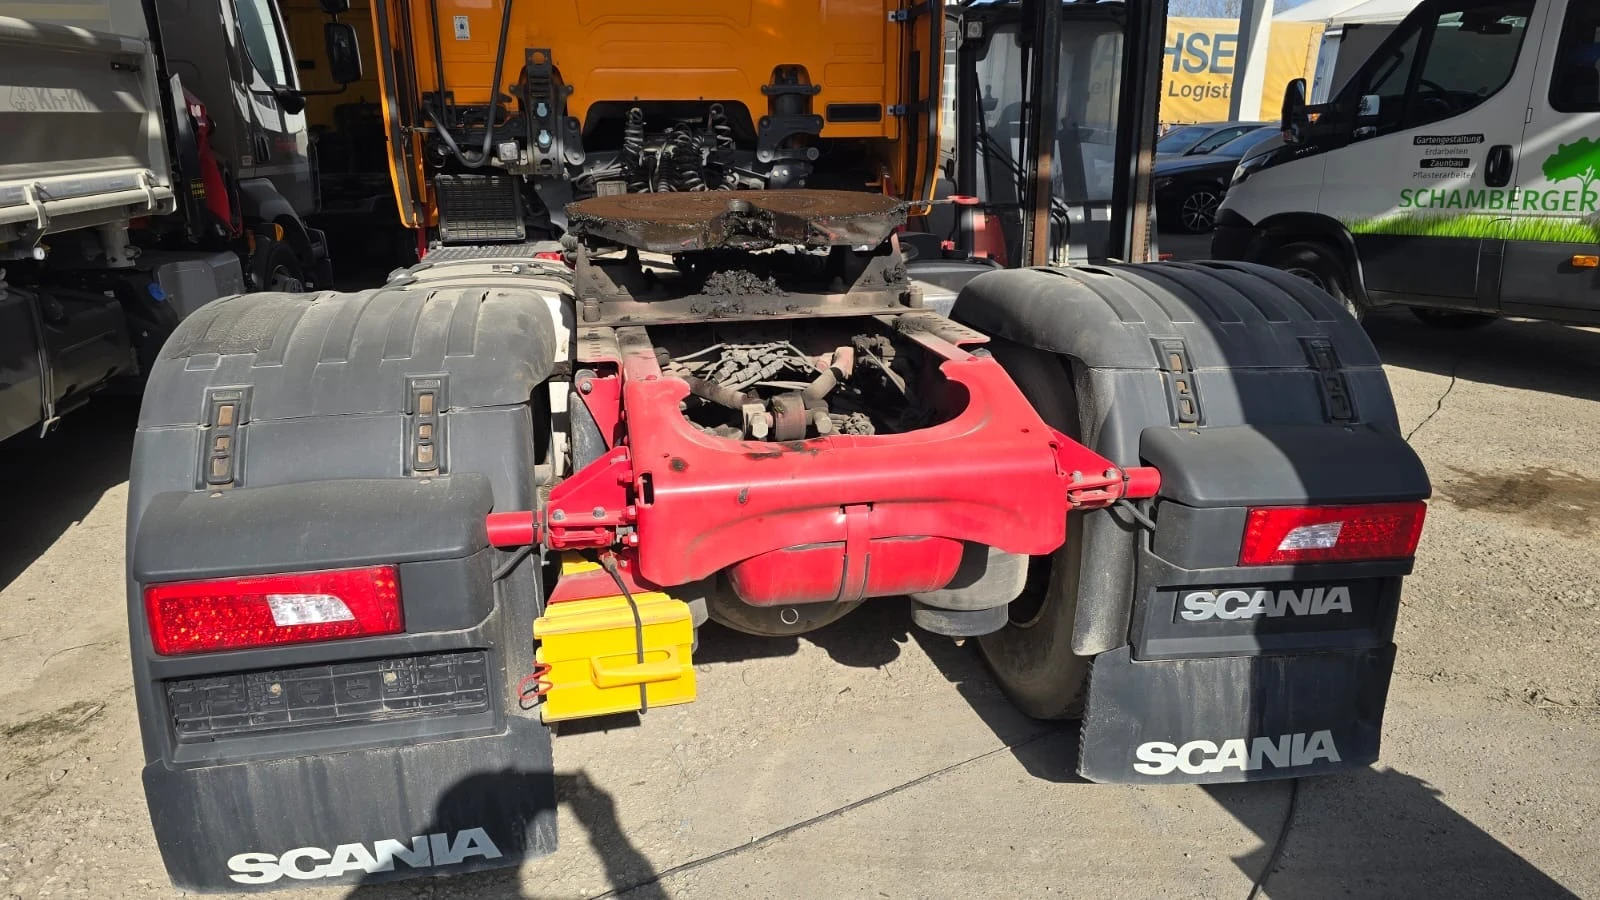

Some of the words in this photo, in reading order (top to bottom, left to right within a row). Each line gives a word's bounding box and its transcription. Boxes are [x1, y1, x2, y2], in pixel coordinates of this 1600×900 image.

[1164, 32, 1239, 74] HSE
[1416, 135, 1482, 145] Gartengestaltung
[1425, 147, 1468, 155] Erdarbeiten
[1412, 171, 1476, 179] Pflasterarbeiten
[1430, 159, 1464, 167] Zaunbau
[1398, 188, 1599, 212] SCHAMBERGER
[1181, 586, 1353, 621] SCANIA
[1133, 729, 1342, 775] SCANIA
[227, 826, 503, 885] SCANIA
